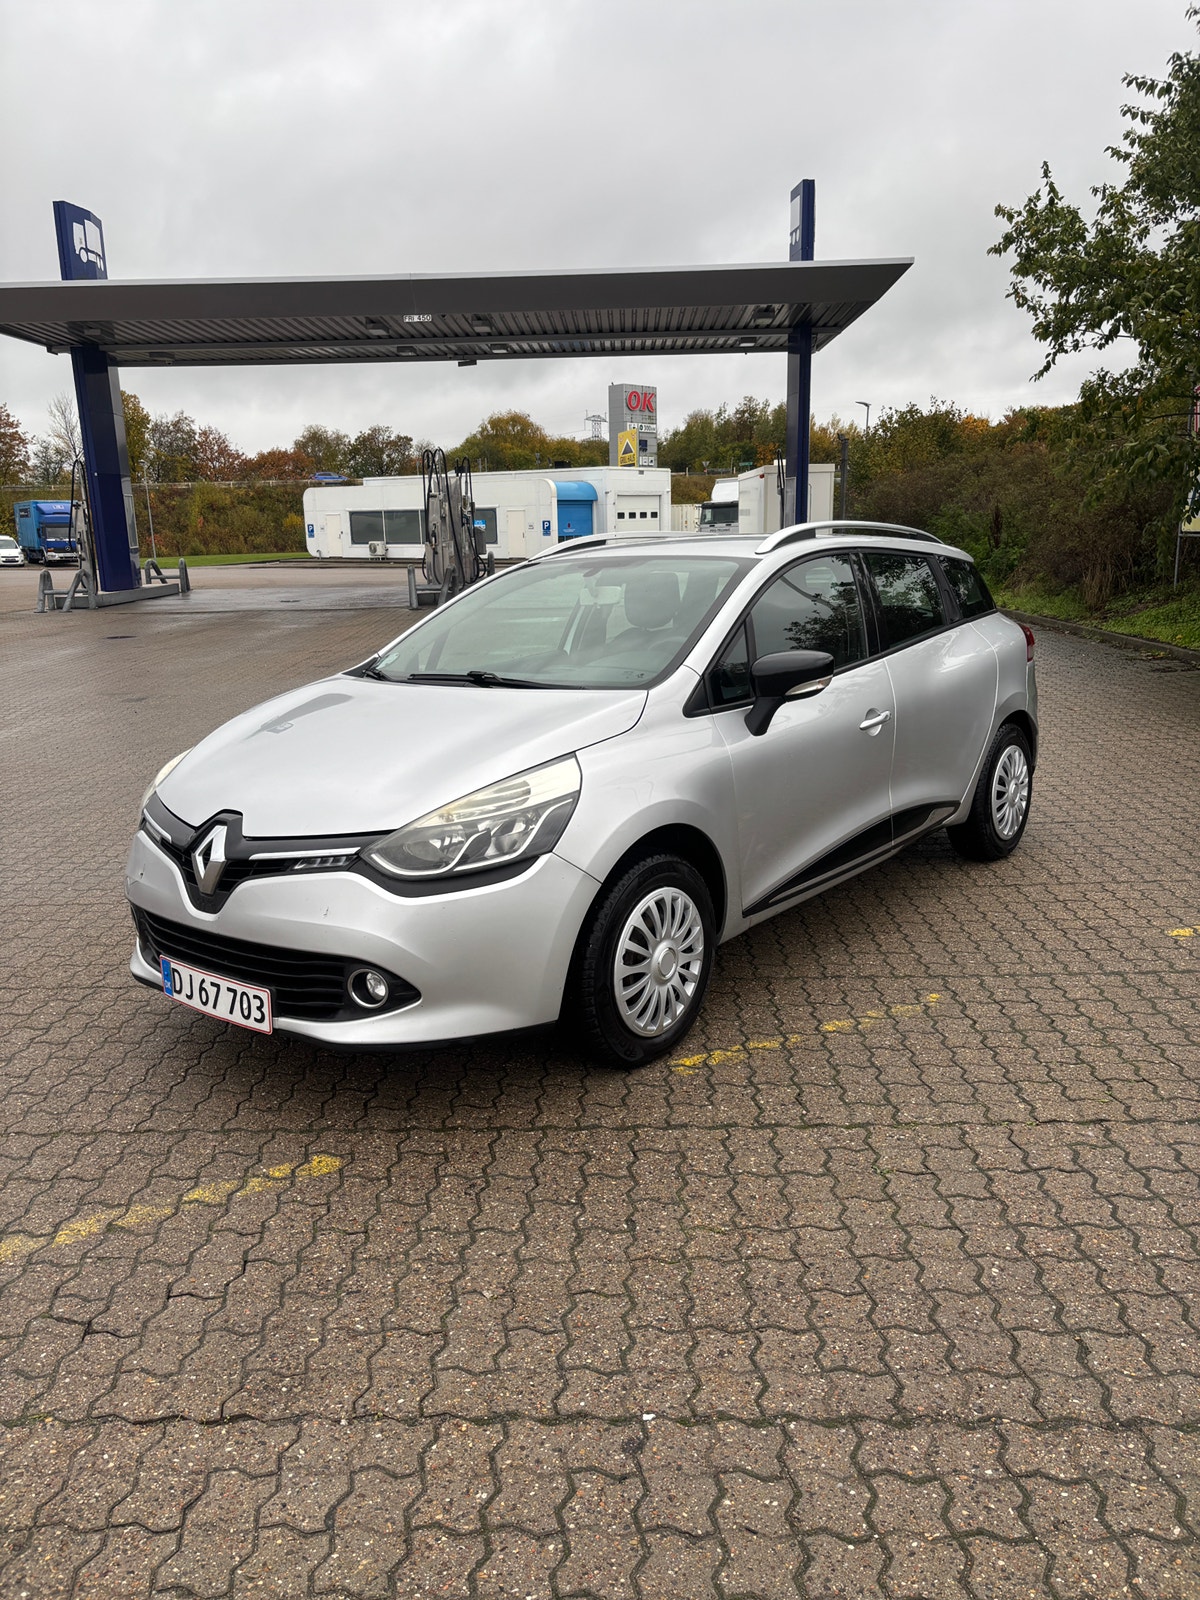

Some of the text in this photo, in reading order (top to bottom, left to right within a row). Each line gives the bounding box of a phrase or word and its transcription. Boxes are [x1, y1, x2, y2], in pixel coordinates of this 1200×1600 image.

[417, 314, 431, 322] 450
[627, 390, 655, 413] OK
[544, 521, 549, 529] P
[172, 967, 266, 1024] DJ 67 703
